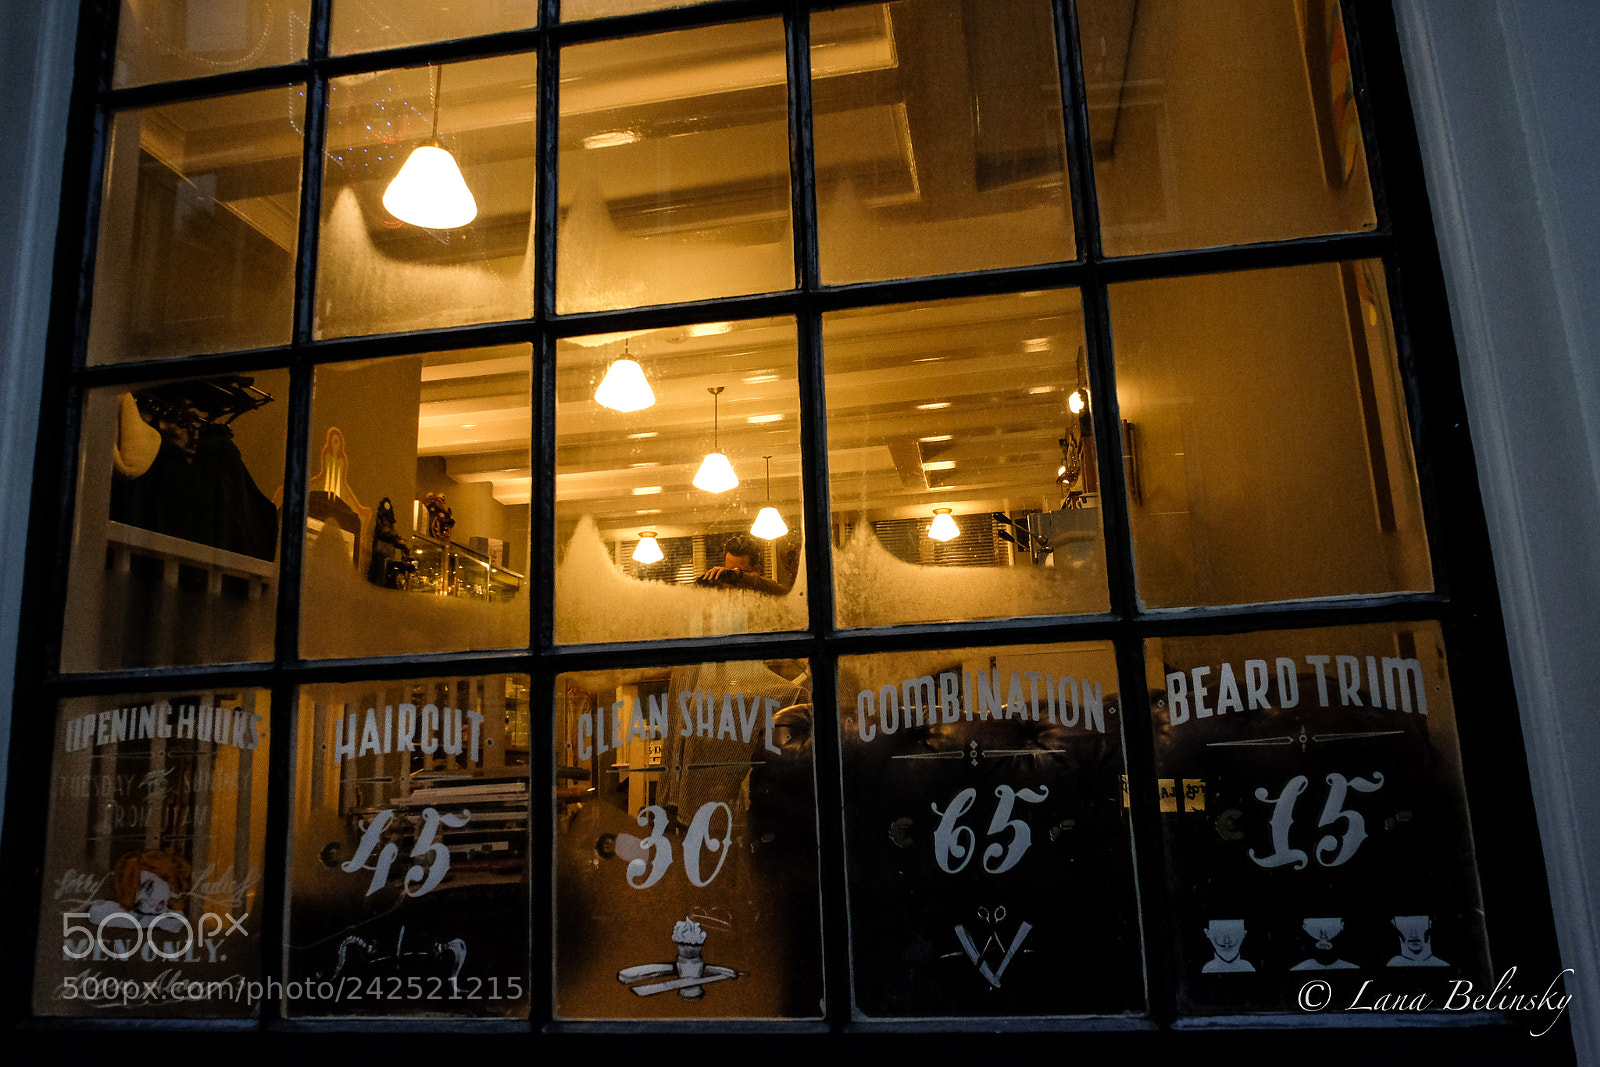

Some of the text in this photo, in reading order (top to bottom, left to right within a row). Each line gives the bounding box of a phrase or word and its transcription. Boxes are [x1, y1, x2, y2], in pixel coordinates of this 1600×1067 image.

[65, 702, 172, 752] OPENING
[577, 690, 782, 761] CLEAN SHAVE
[856, 669, 1106, 743] COMBINATION
[1165, 655, 1428, 727] BEARD TRIM
[333, 703, 484, 765] HAIRCUT
[341, 807, 471, 897] 45
[625, 801, 734, 890] 30
[931, 784, 1050, 874] 65
[1248, 771, 1384, 870] 15
